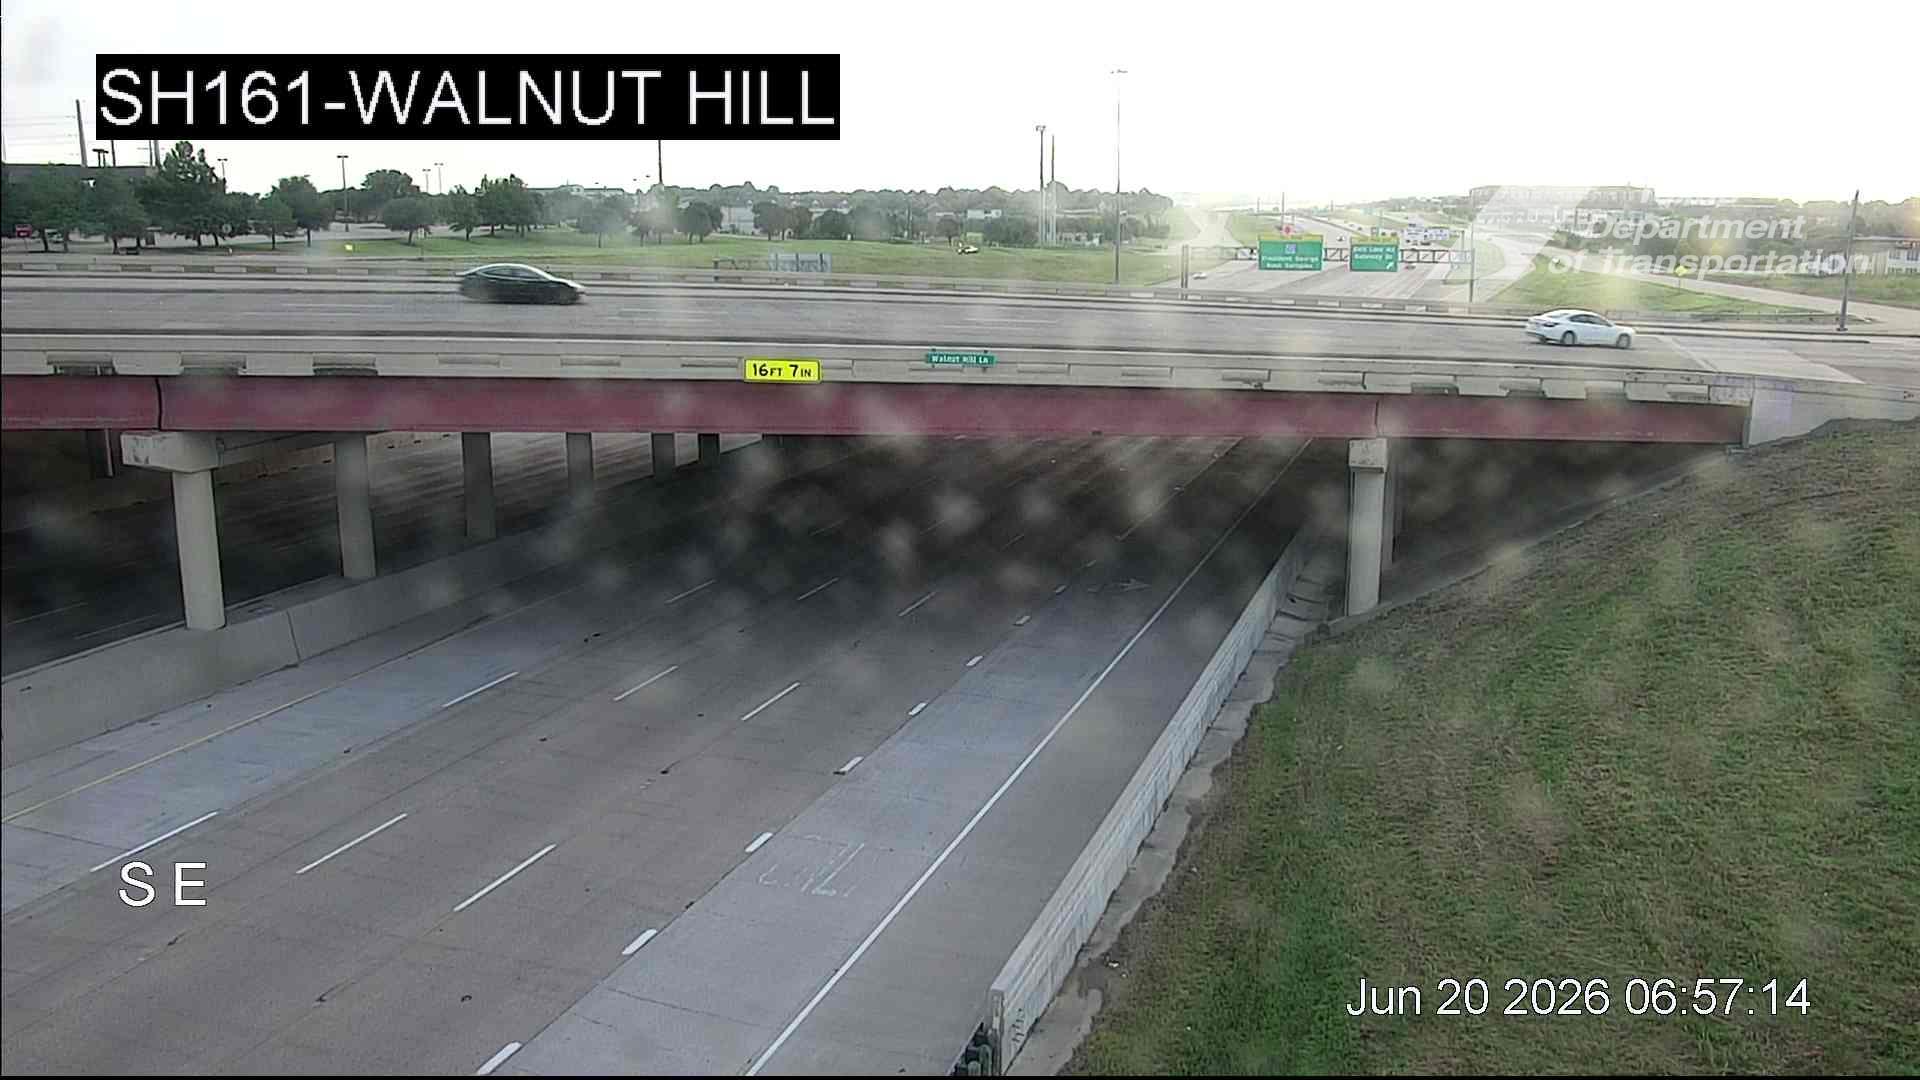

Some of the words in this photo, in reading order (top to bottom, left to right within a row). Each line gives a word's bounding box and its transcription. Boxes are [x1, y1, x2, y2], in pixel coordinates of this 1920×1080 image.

[931, 355, 960, 363] Walnut
[962, 355, 976, 364] Hill
[978, 355, 989, 364] Ln
